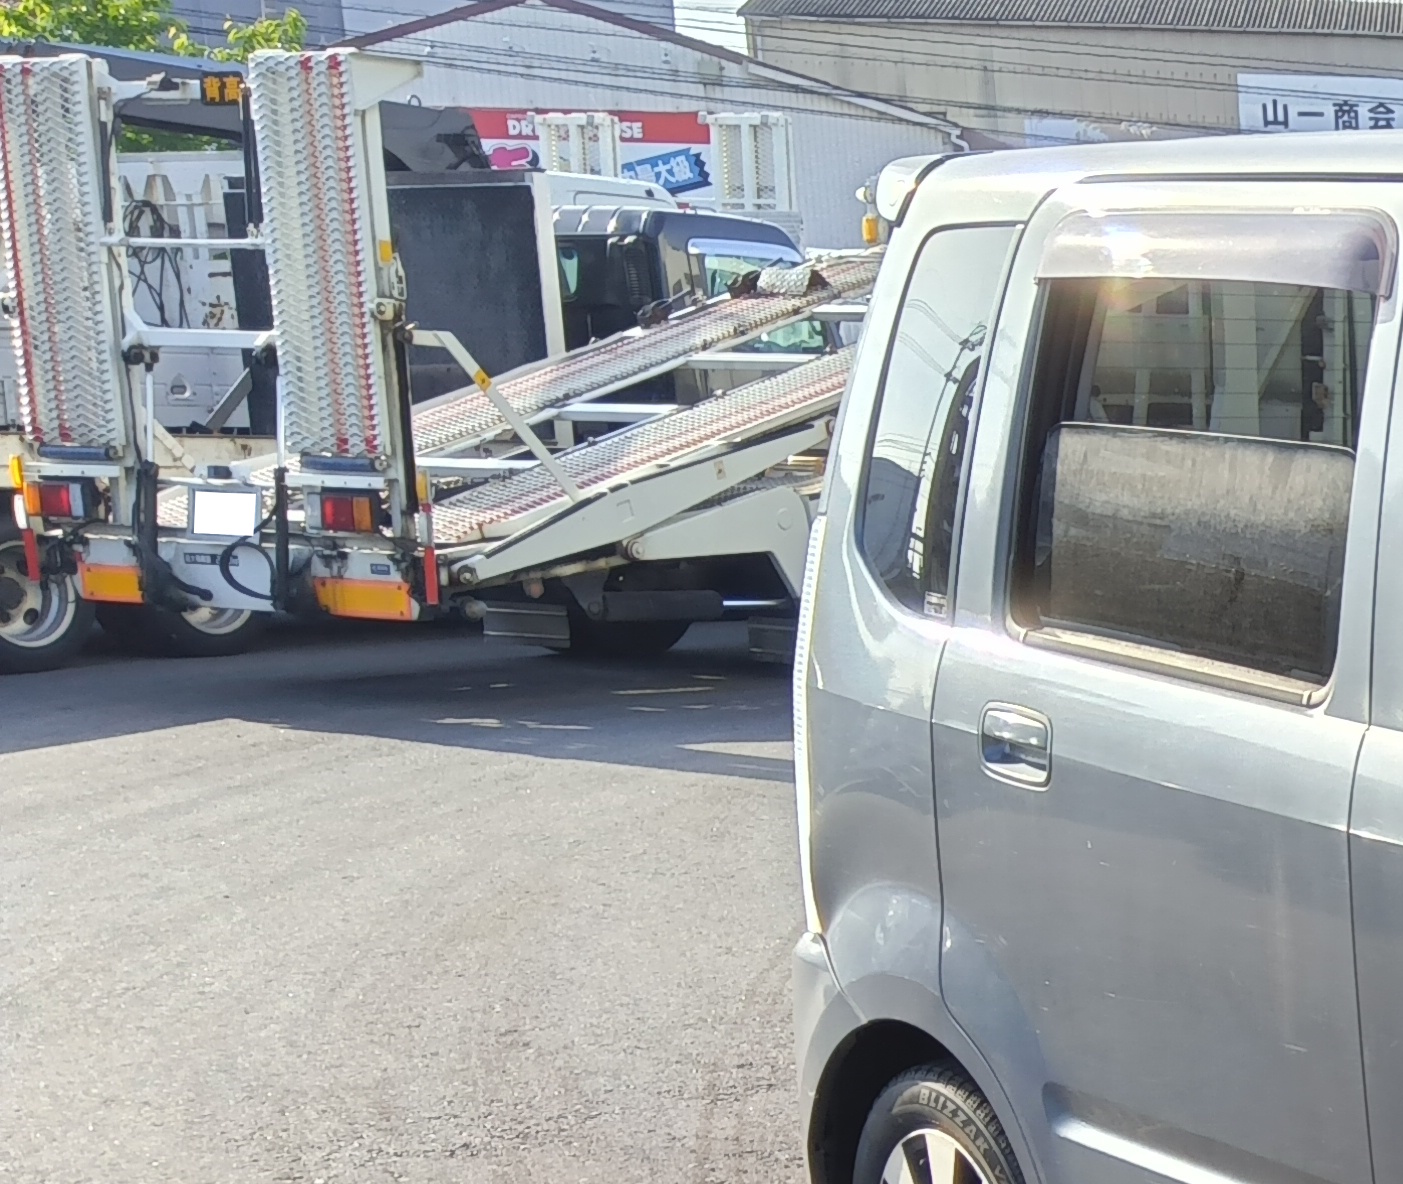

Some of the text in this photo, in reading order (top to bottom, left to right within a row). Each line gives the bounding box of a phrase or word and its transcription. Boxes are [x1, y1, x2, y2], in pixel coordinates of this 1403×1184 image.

[203, 75, 242, 102] 背高
[1262, 98, 1396, 131] 山一商会
[918, 1088, 991, 1156] BLIZZAK
